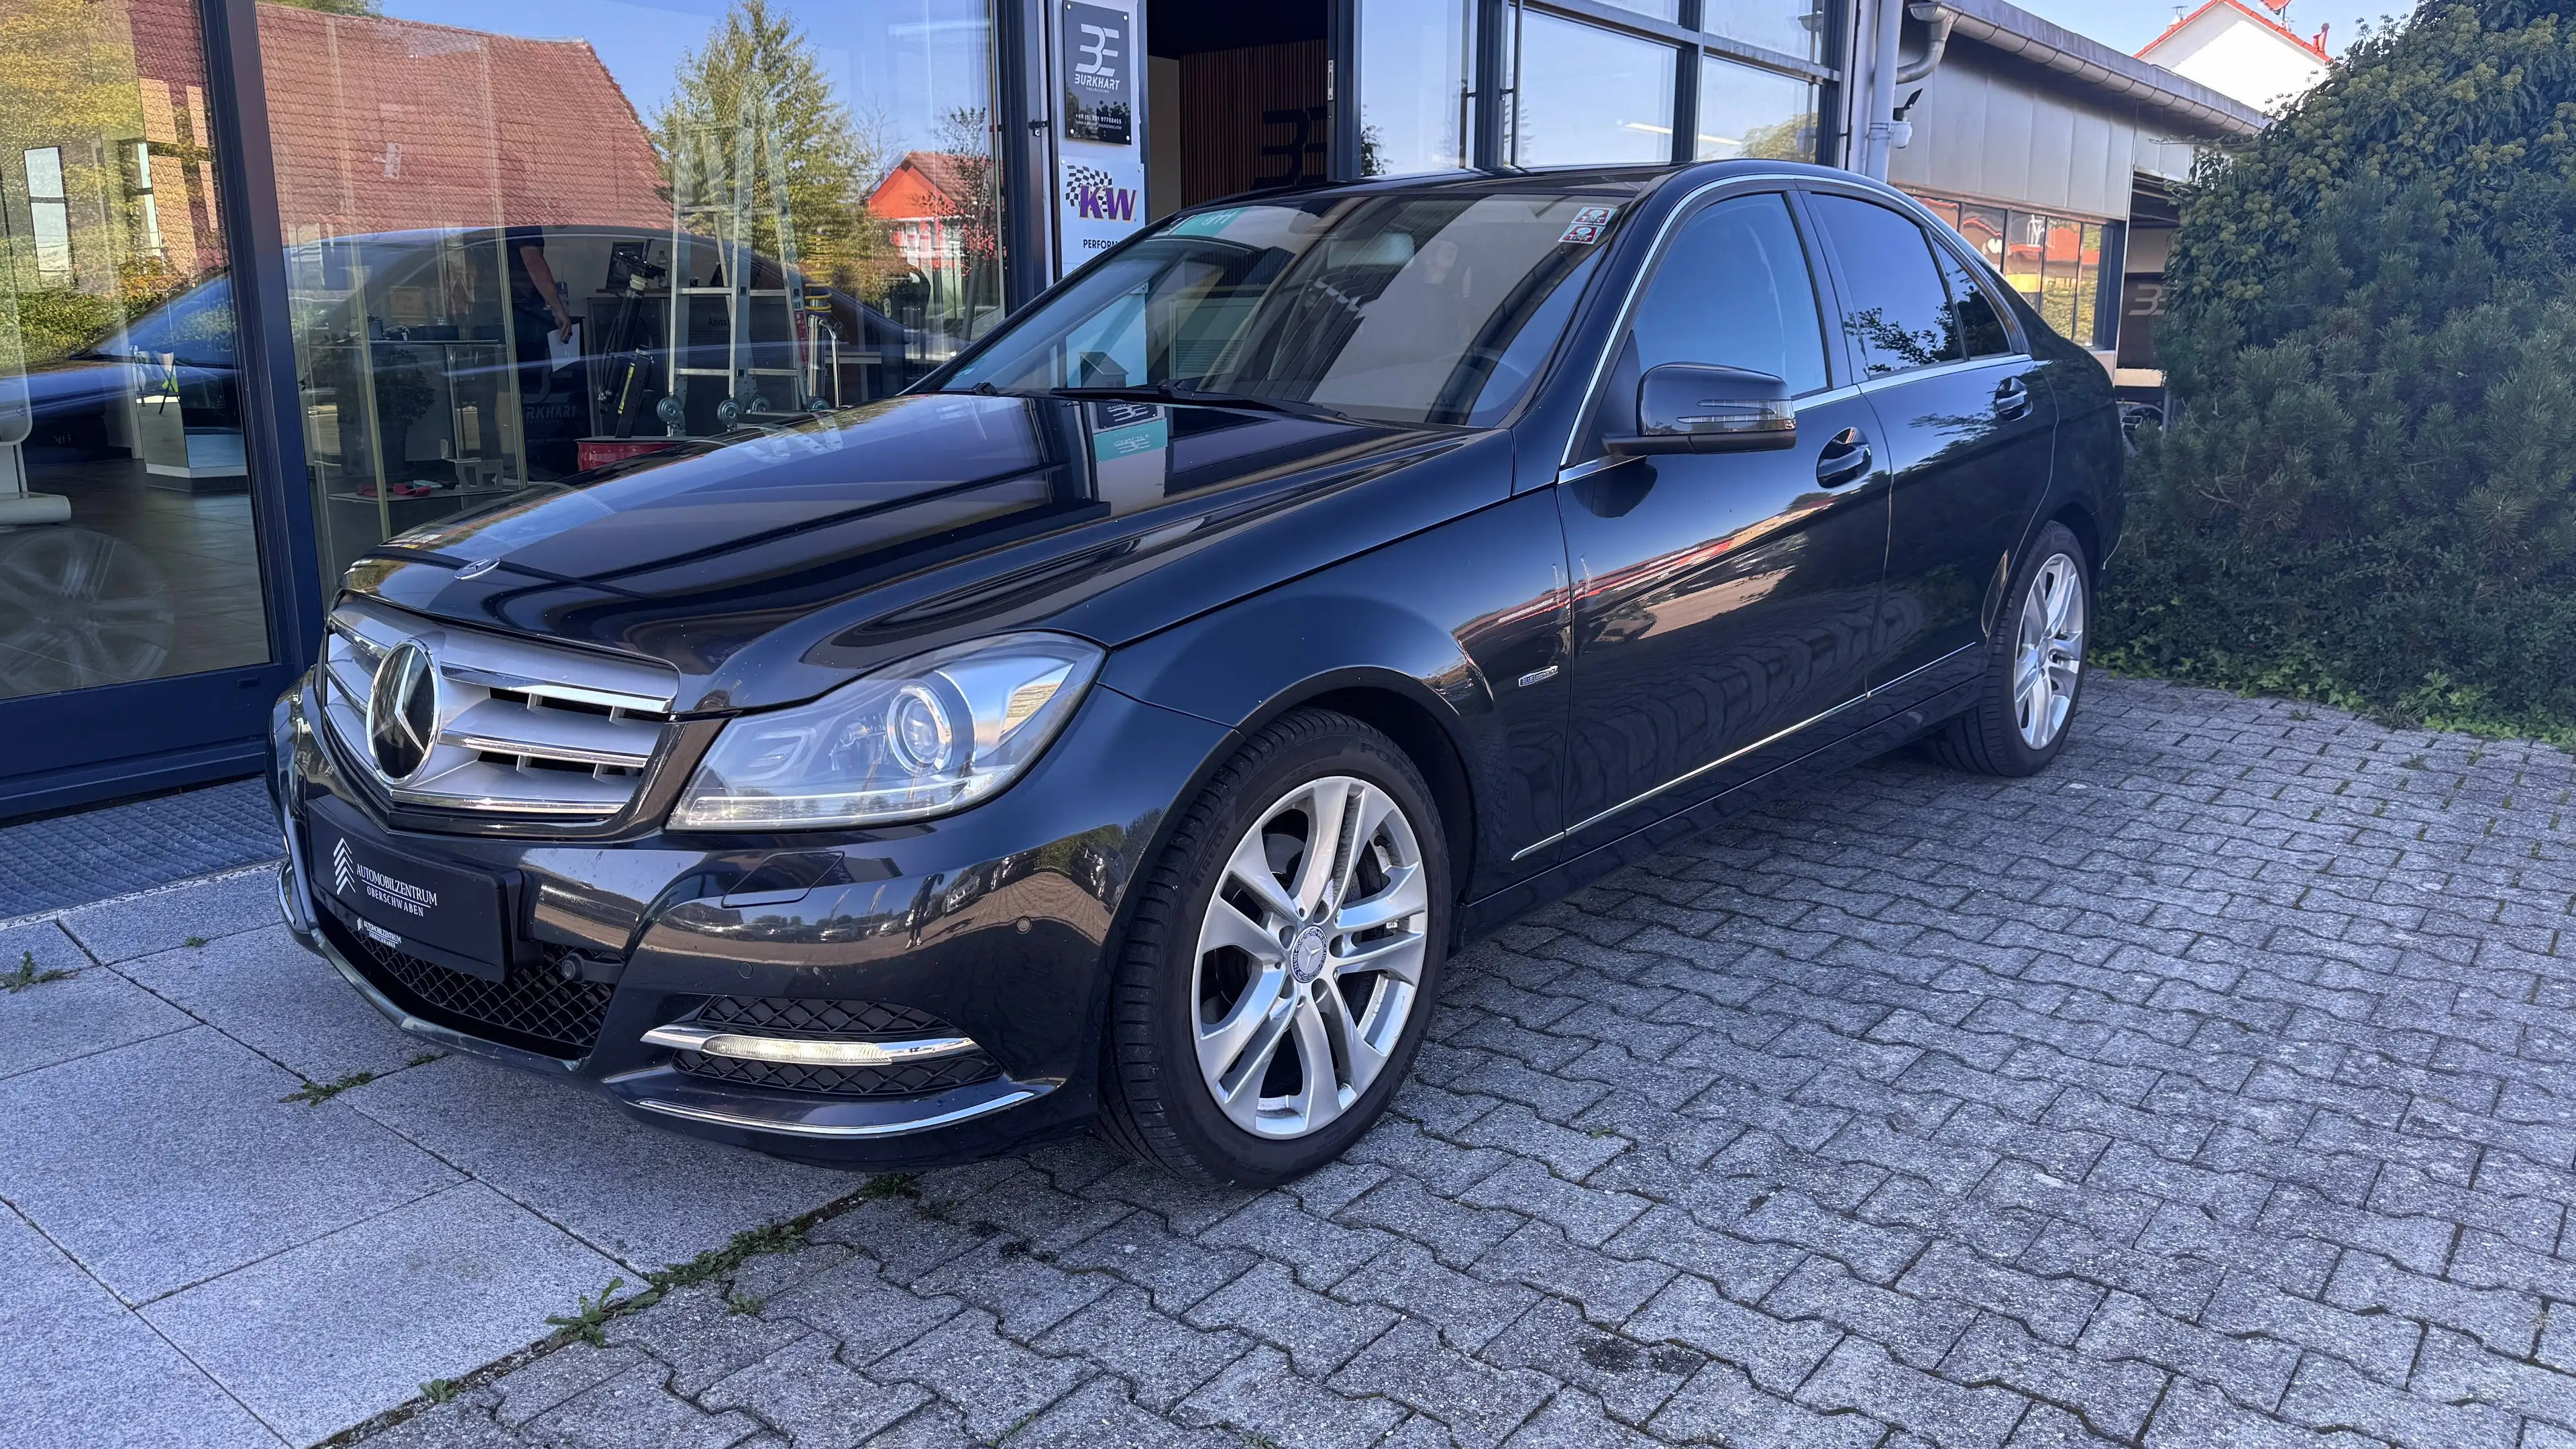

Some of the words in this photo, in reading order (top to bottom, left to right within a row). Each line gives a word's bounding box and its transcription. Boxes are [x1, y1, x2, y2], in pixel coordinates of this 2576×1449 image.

[1074, 73, 1120, 91] BURKHART
[1079, 184, 1138, 223] KW
[525, 405, 578, 419] RKHART
[356, 863, 438, 906] AUTOMOBILZENTRUM
[366, 885, 424, 917] OBERSCHWABEN
